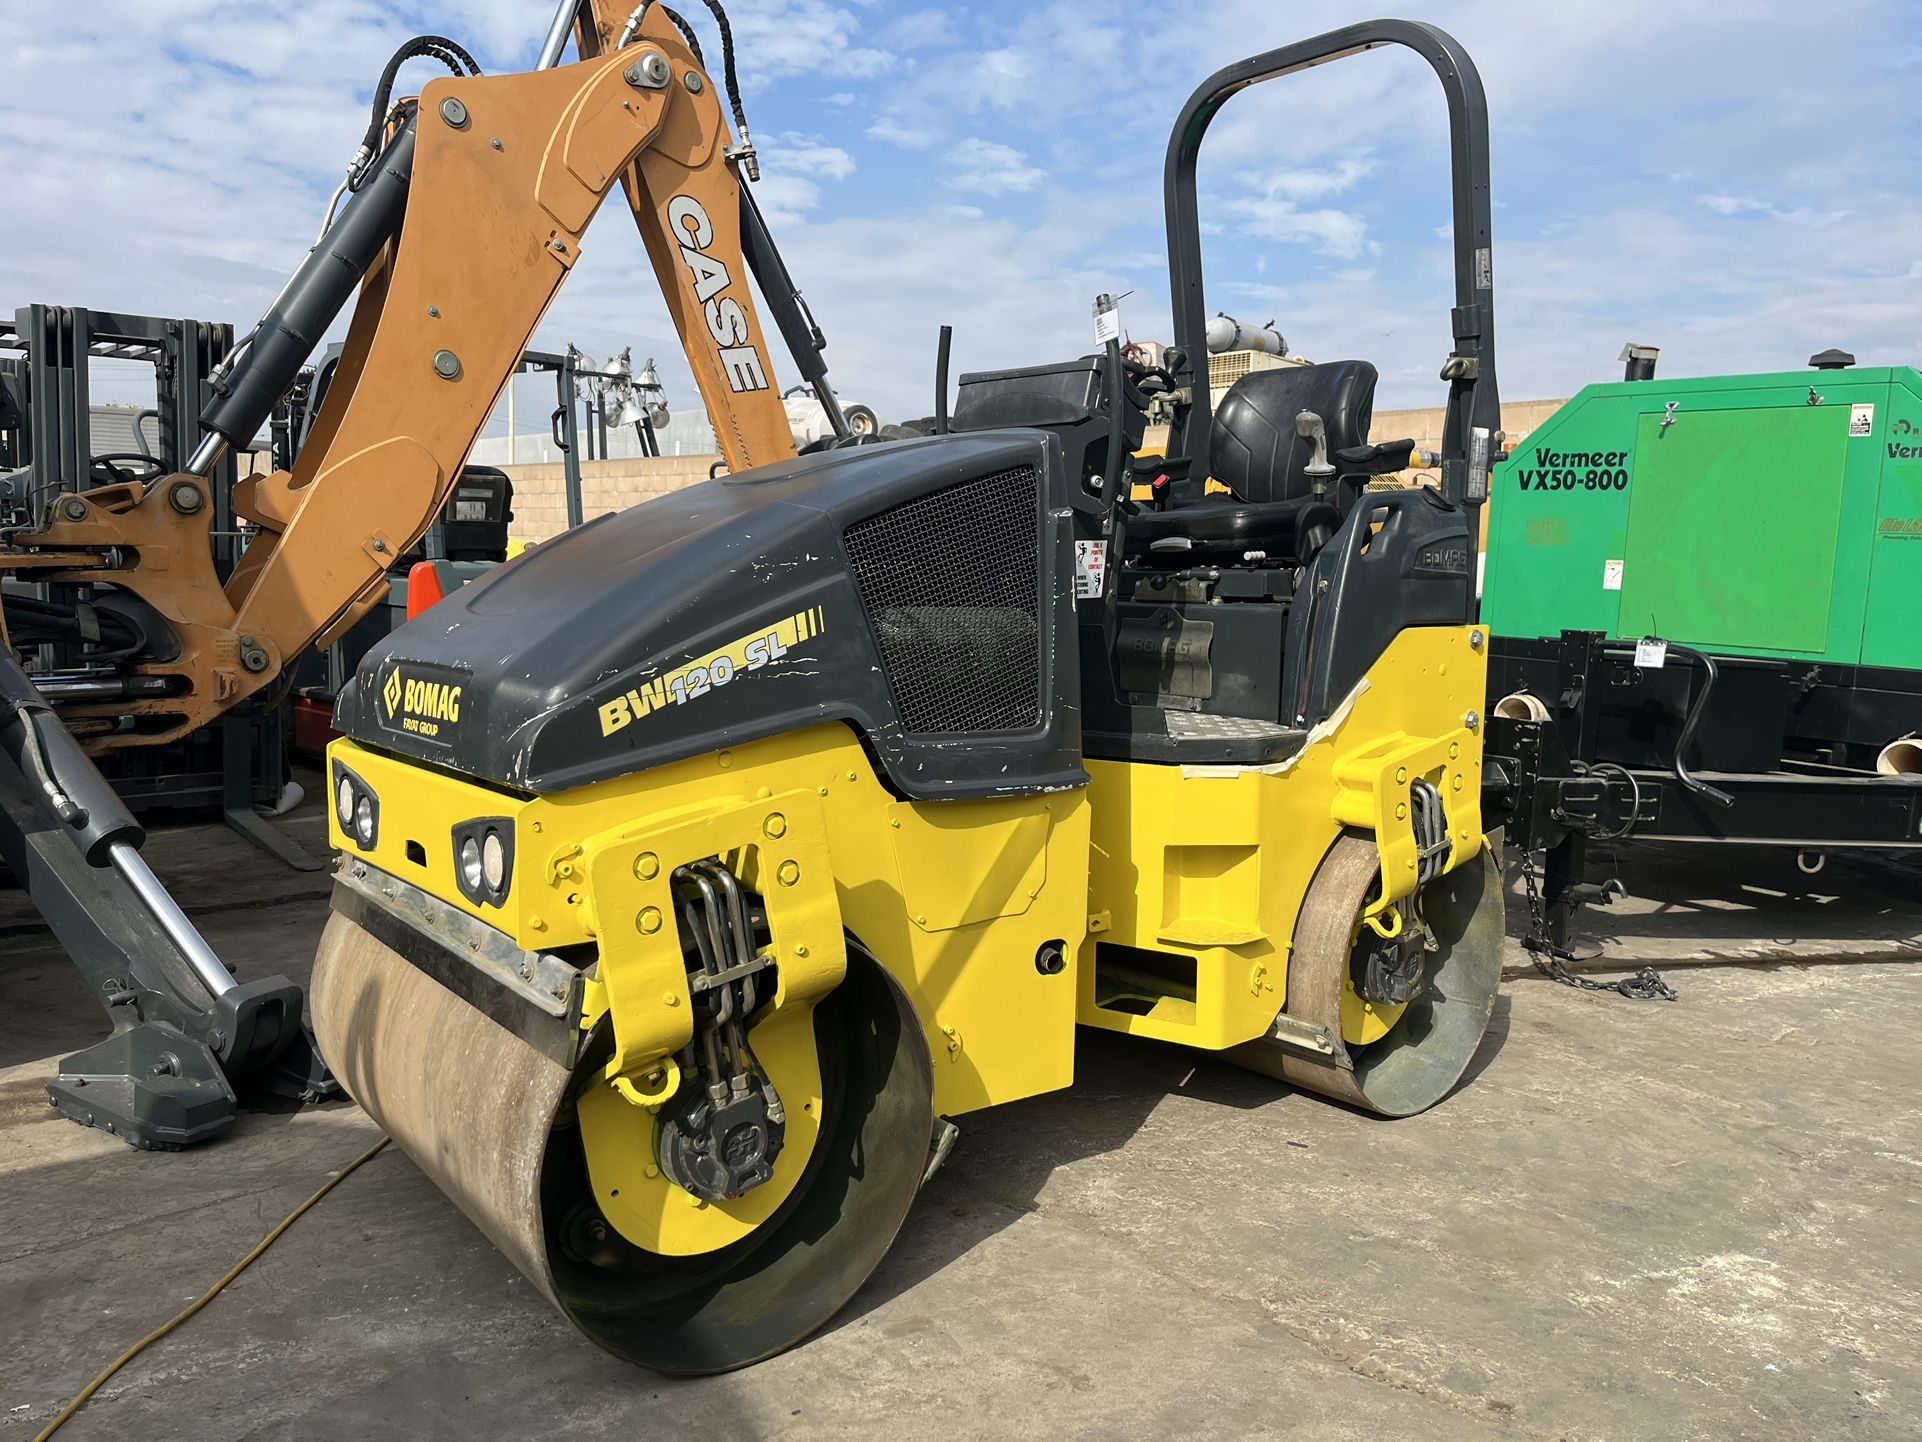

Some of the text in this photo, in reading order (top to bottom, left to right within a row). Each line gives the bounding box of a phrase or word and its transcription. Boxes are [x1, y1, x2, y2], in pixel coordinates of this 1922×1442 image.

[667, 195, 770, 393] CASE
[1535, 448, 1628, 468] Vermeer
[1887, 442, 1922, 459] Ver
[1518, 469, 1629, 491] VX50-800
[744, 631, 788, 672] SL
[403, 678, 462, 723] BOMAG
[402, 717, 439, 737] FAYAT GROUP
